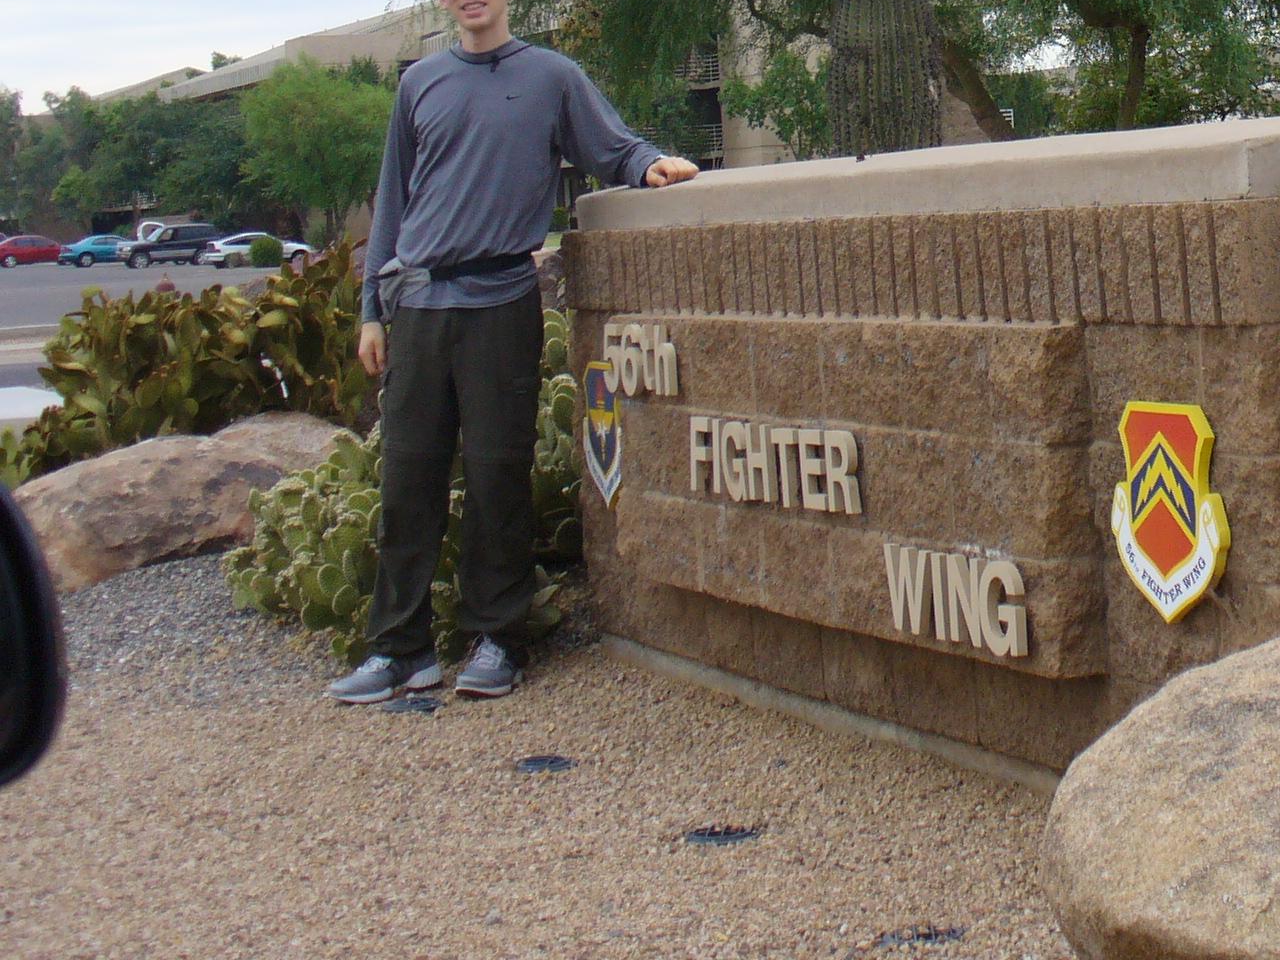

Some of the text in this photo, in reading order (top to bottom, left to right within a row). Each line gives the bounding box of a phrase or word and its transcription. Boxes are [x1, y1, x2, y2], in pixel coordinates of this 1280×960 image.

[604, 323, 677, 396] 56th
[690, 416, 862, 514] FIGHTER
[885, 545, 1029, 657] WING
[1141, 570, 1182, 604] FIGHTER
[1183, 557, 1206, 589] WING
